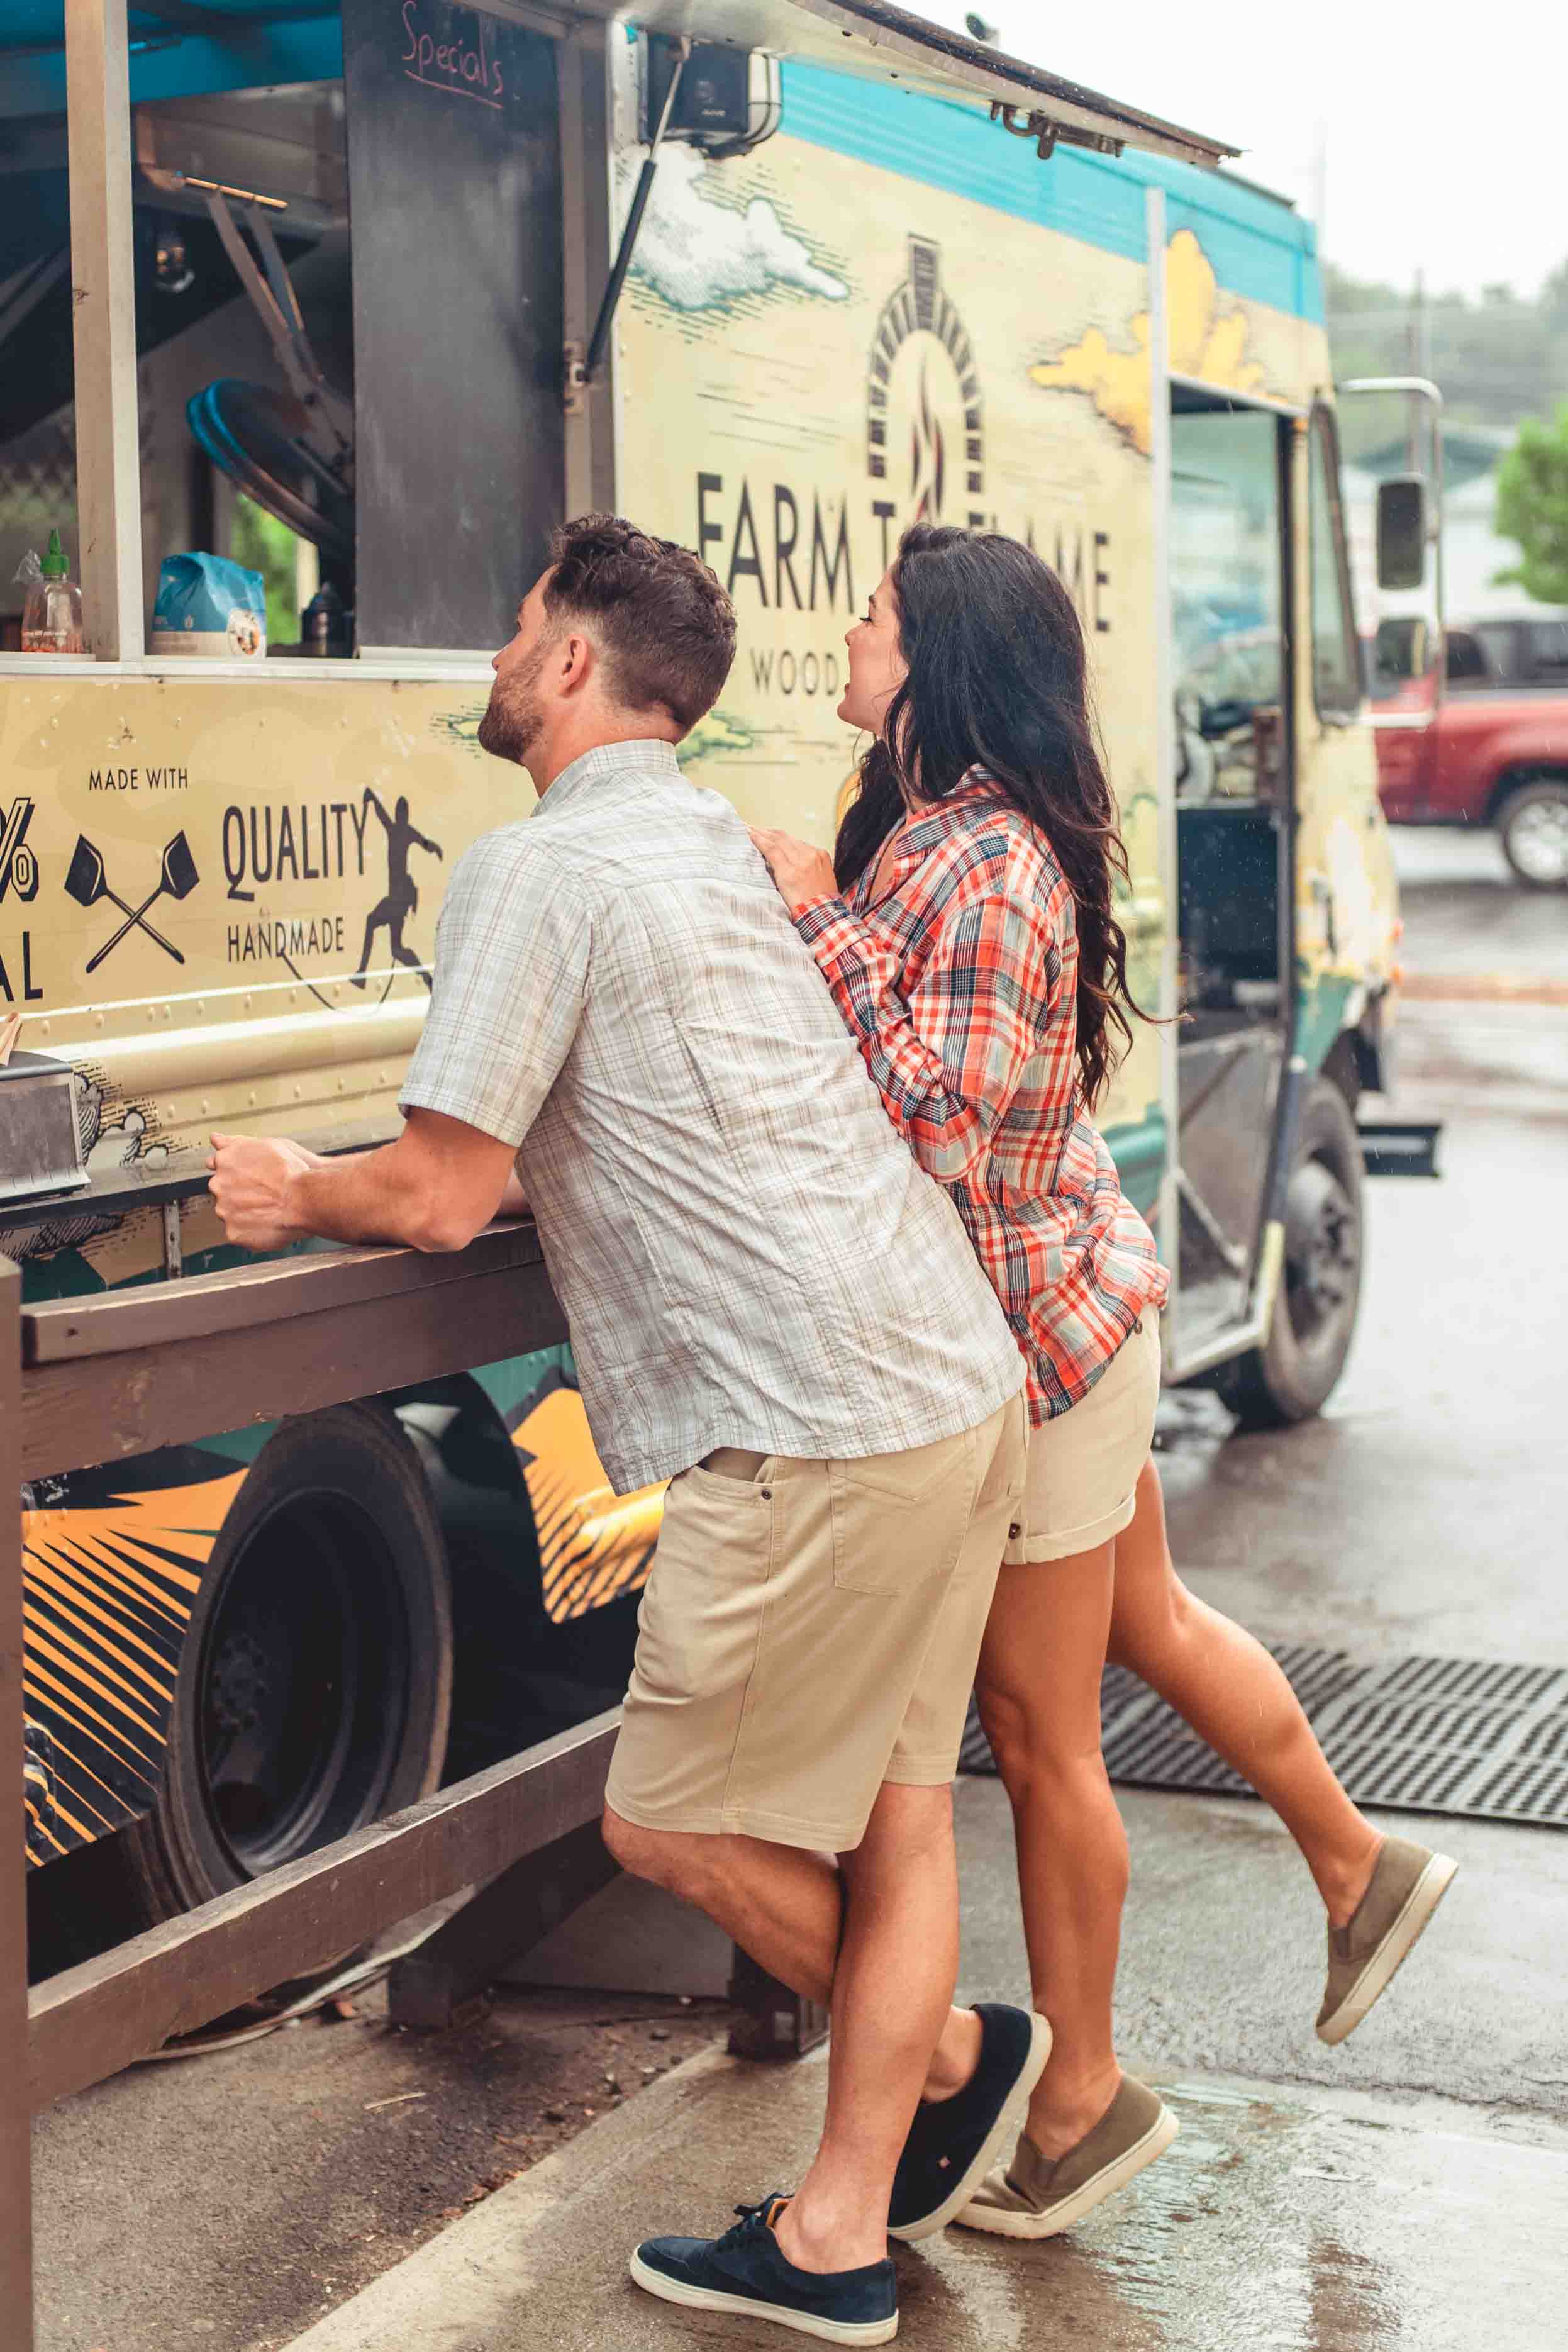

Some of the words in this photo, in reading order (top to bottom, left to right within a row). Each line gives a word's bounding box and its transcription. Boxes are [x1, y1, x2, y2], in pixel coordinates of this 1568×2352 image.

[403, 1, 503, 94] Specials
[698, 471, 855, 615] FARM
[750, 648, 840, 696] WOOD
[89, 768, 138, 790] MADE
[146, 767, 187, 789] WITH
[223, 803, 369, 902] QUALITY
[228, 915, 344, 962] HANDMADE
